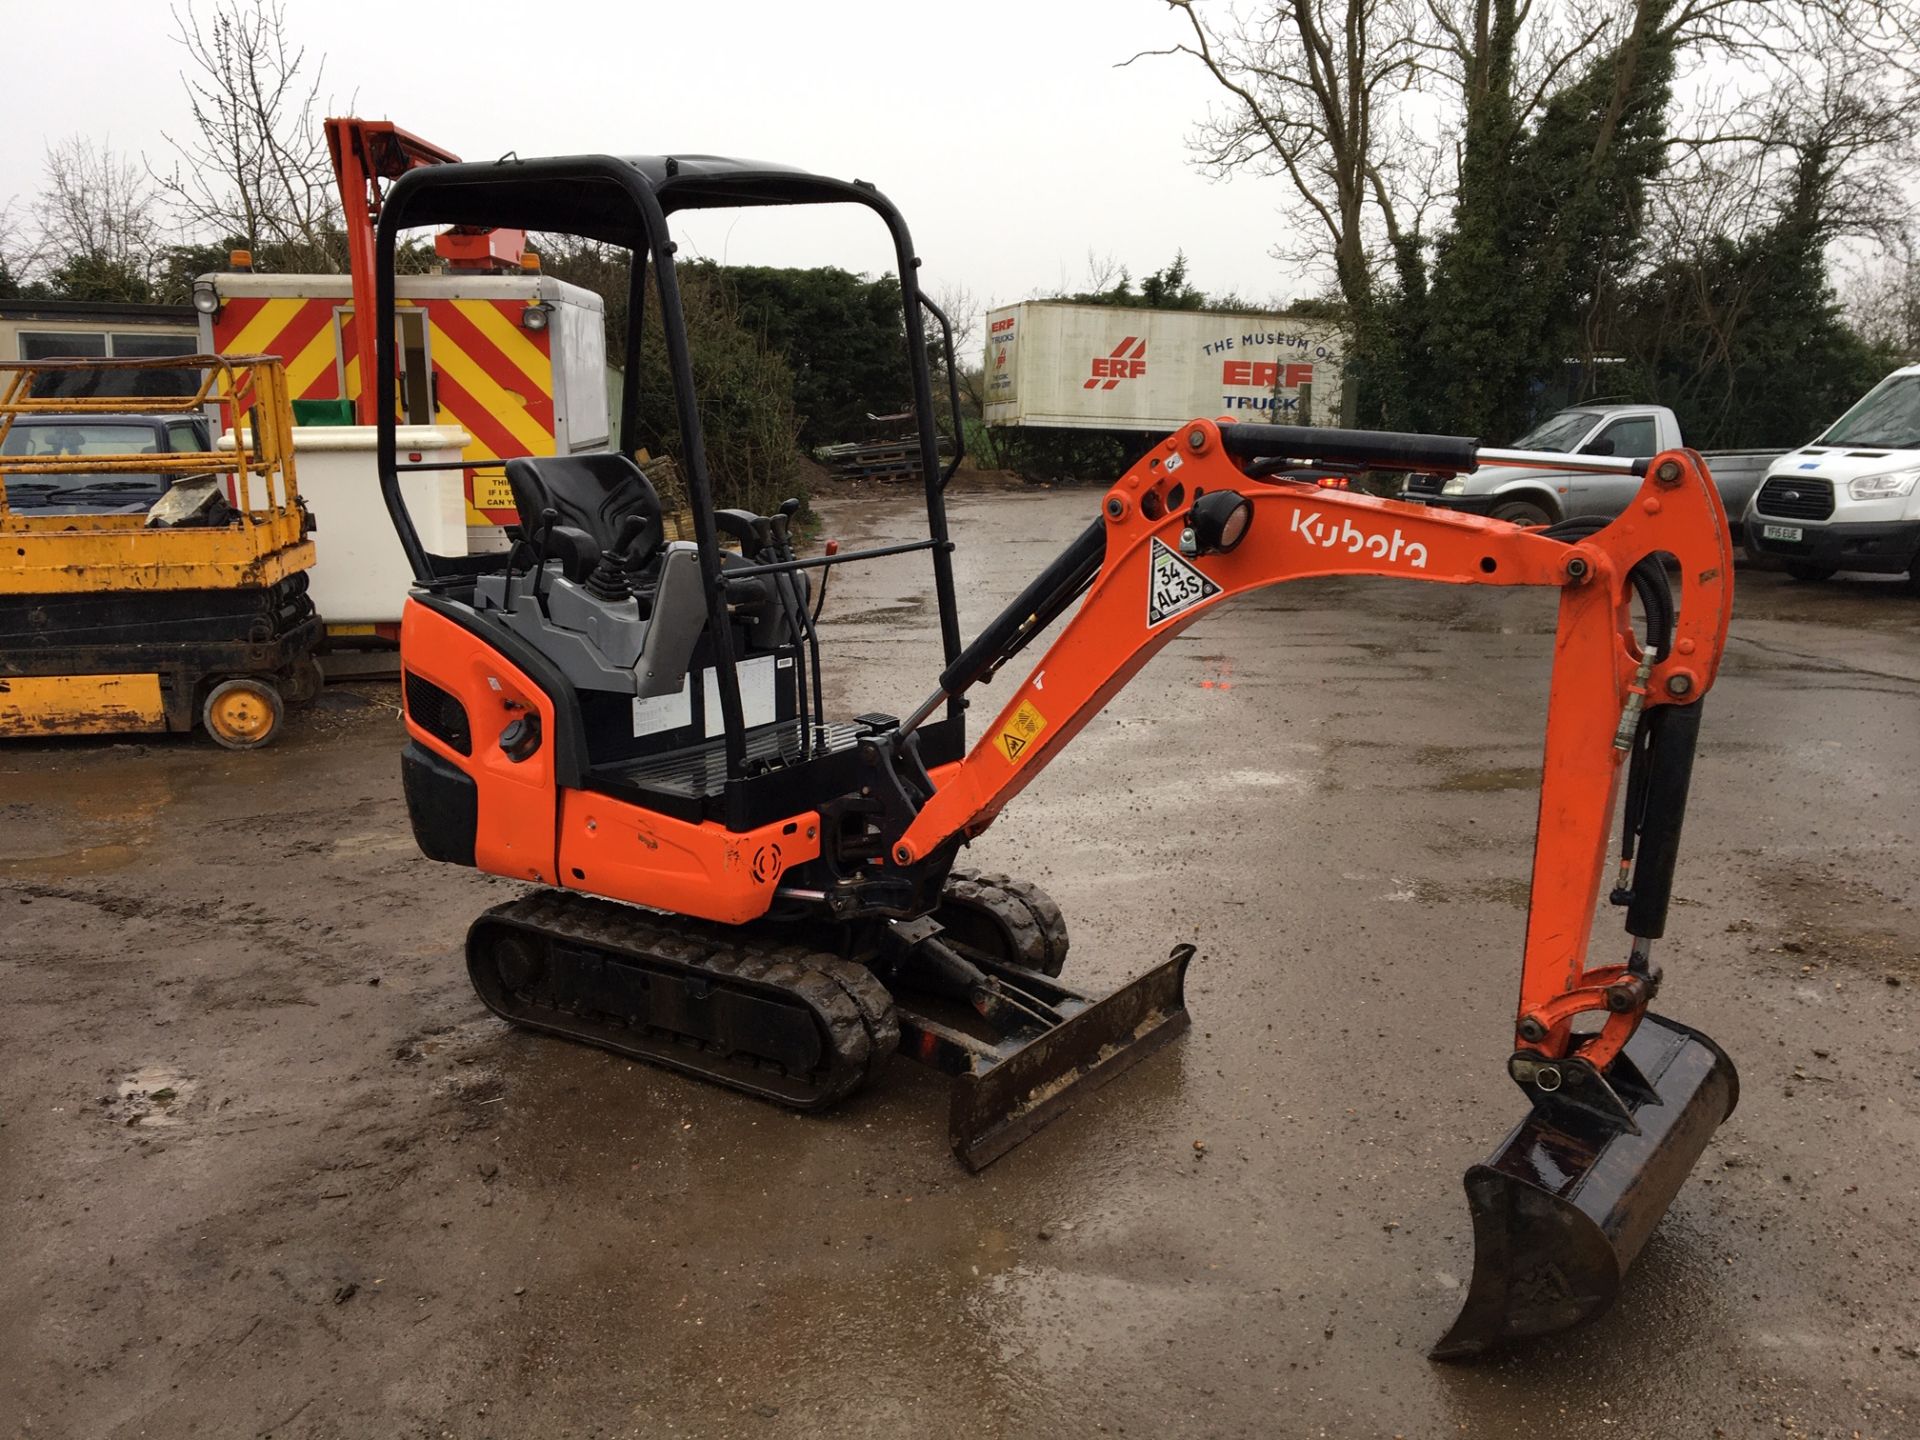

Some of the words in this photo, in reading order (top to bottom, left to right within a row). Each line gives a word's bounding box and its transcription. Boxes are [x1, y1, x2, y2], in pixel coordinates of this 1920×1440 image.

[992, 316, 1015, 332] ERF
[1203, 338, 1234, 356] THE
[1242, 332, 1309, 350] MUSEUM
[1316, 346, 1335, 360] OF
[1092, 358, 1146, 379] ERF
[1222, 360, 1313, 388] ERF
[1290, 508, 1428, 569] Kubota
[1157, 562, 1181, 586] 34
[1157, 576, 1200, 610] AL3S
